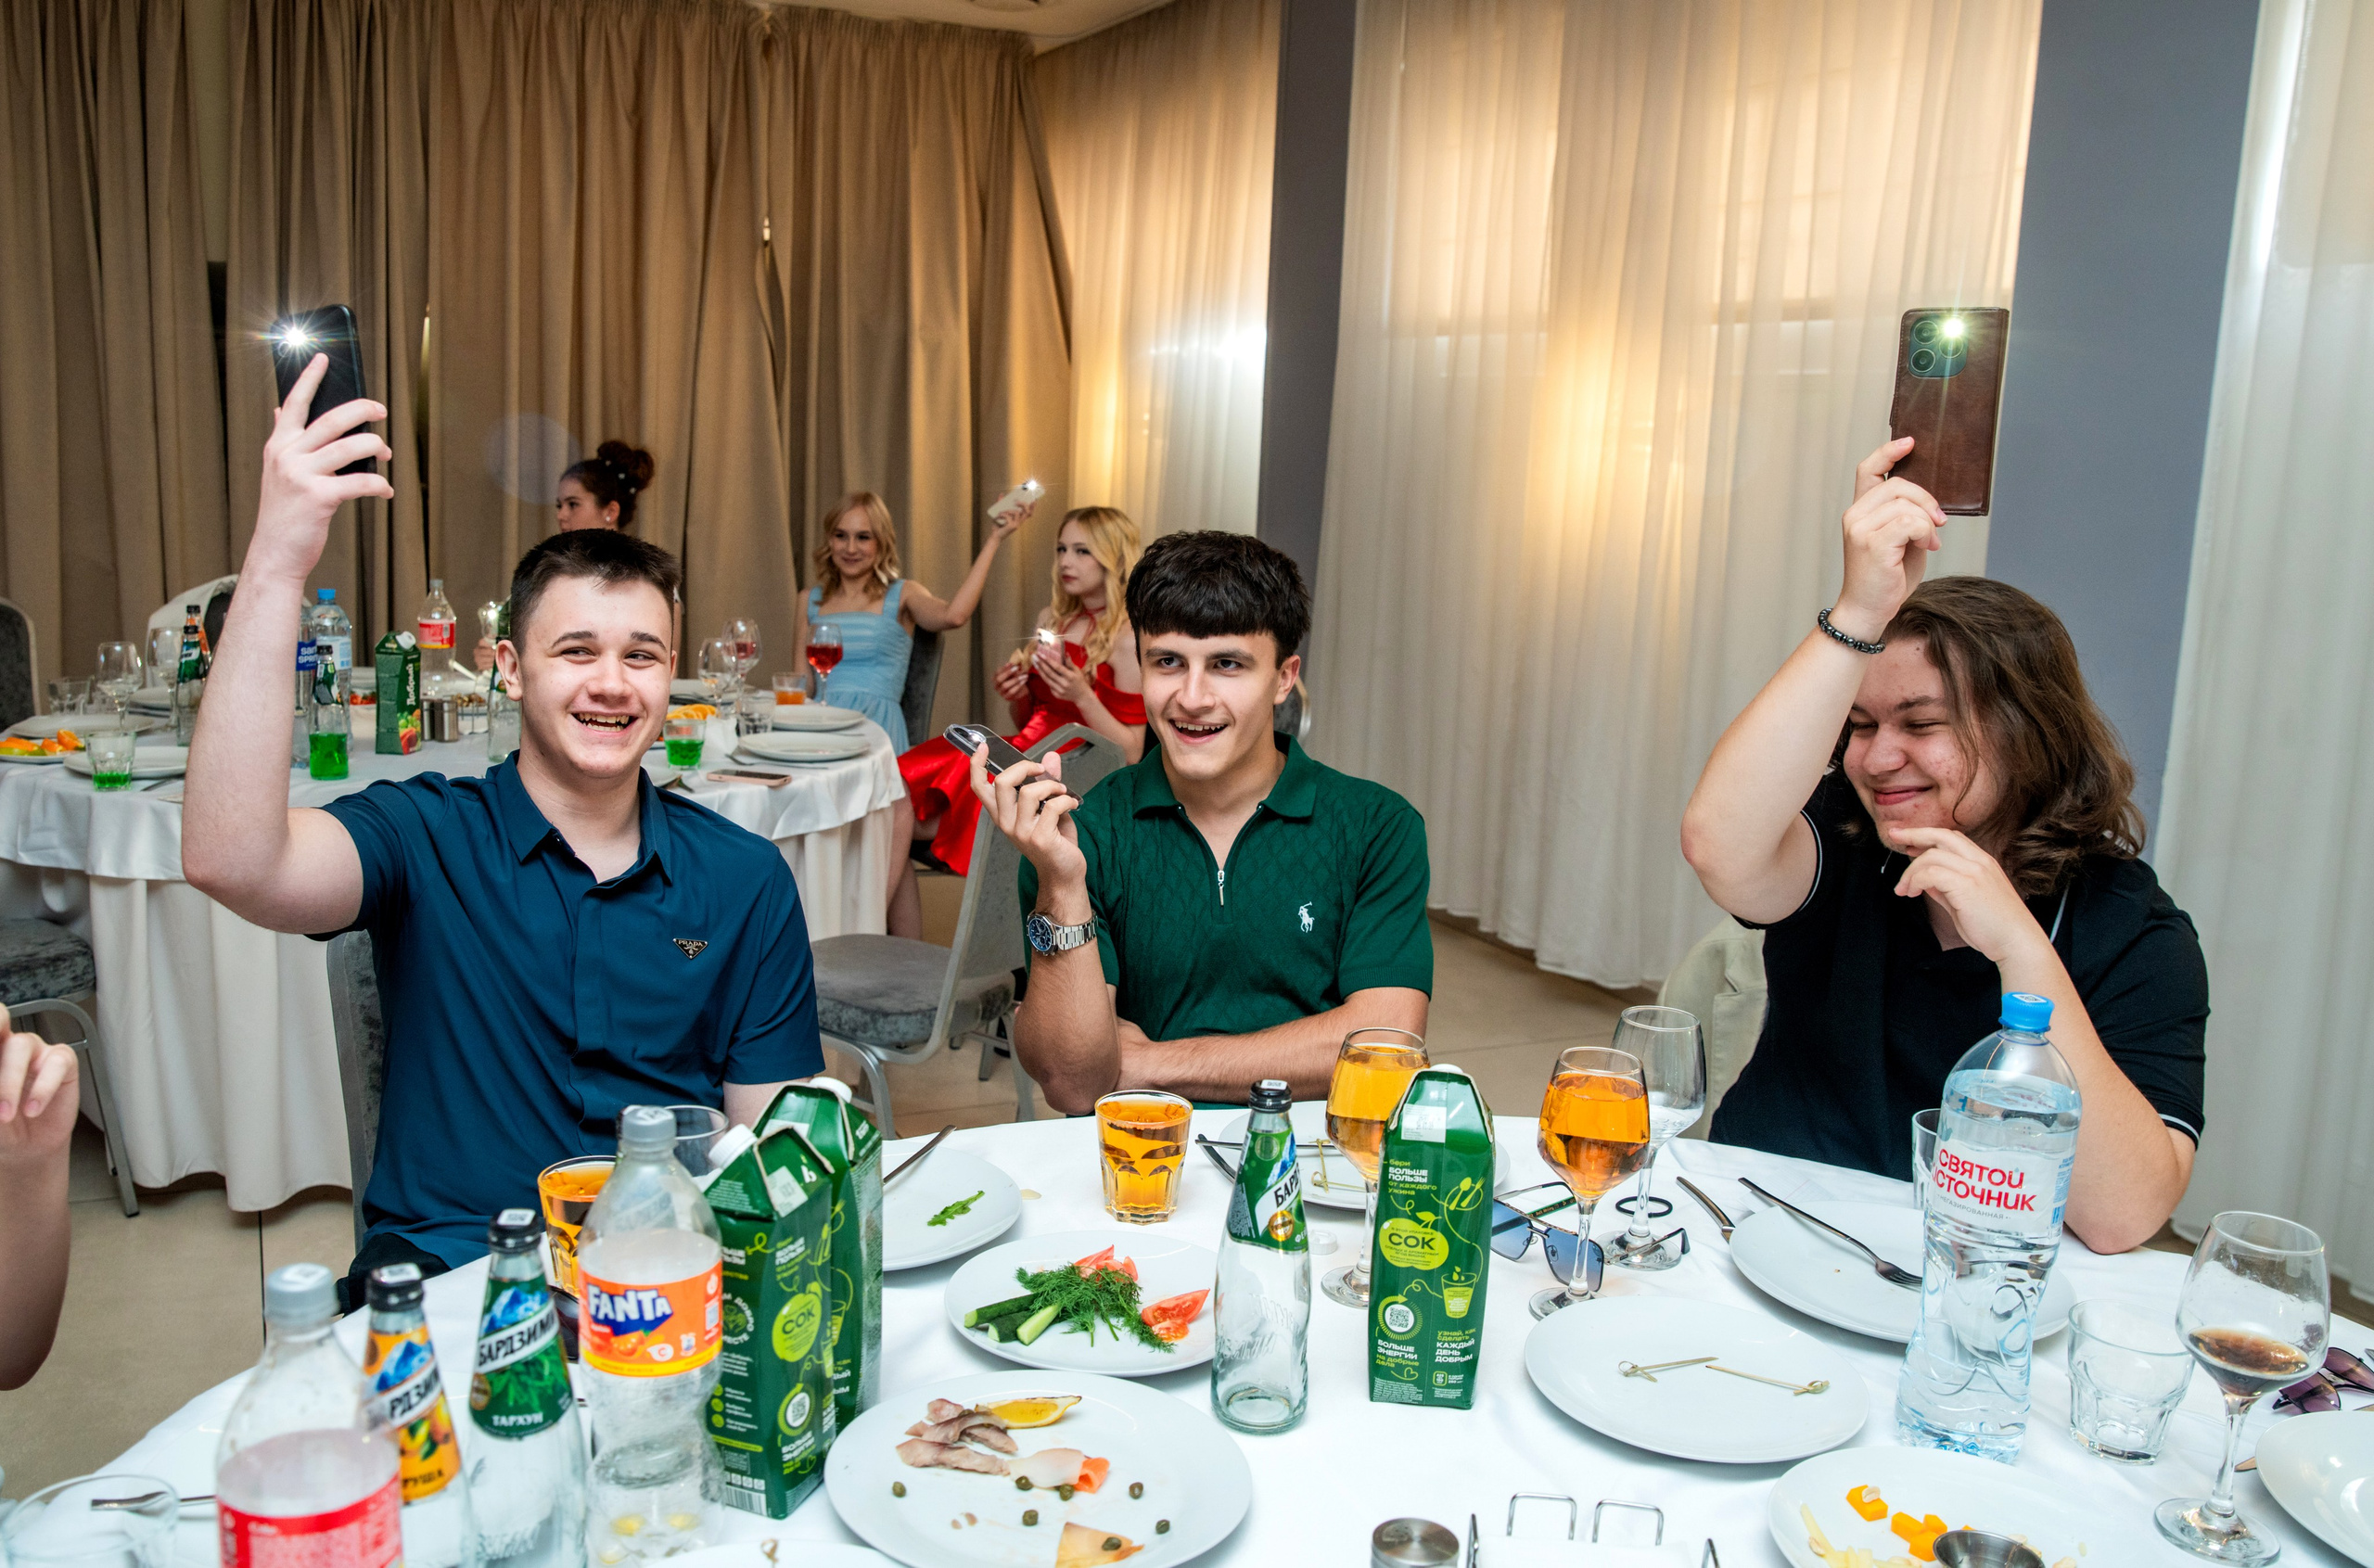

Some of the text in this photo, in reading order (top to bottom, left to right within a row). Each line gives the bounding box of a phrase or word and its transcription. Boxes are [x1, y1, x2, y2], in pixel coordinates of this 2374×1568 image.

[406, 662, 416, 707] Добрый
[1389, 1158, 1410, 1166] бери
[1388, 1166, 1428, 1177] БОЛЬШЕ
[1388, 1173, 1428, 1183] ПОЛЬЗЫ
[1388, 1187, 1415, 1195] ужина
[1399, 1182, 1437, 1191] каждого
[1939, 1194, 2004, 1219] НЕГАЗИРОВАННАЯ
[1388, 1232, 1436, 1251] СОК
[587, 1282, 673, 1323] FANTA
[782, 1303, 815, 1335] СОК
[1377, 1339, 1415, 1353] БОЛЬШЕ
[1436, 1338, 1475, 1349] КАЖДЫЙ
[1377, 1346, 1418, 1360] ЭНЕРГИИ
[1436, 1348, 1461, 1357] ДЕНЬ
[1375, 1359, 1396, 1368] дела
[1386, 1357, 1420, 1367] добрые
[1435, 1354, 1474, 1363] ДОБРЫМ
[491, 1411, 544, 1427] ТАРХУН
